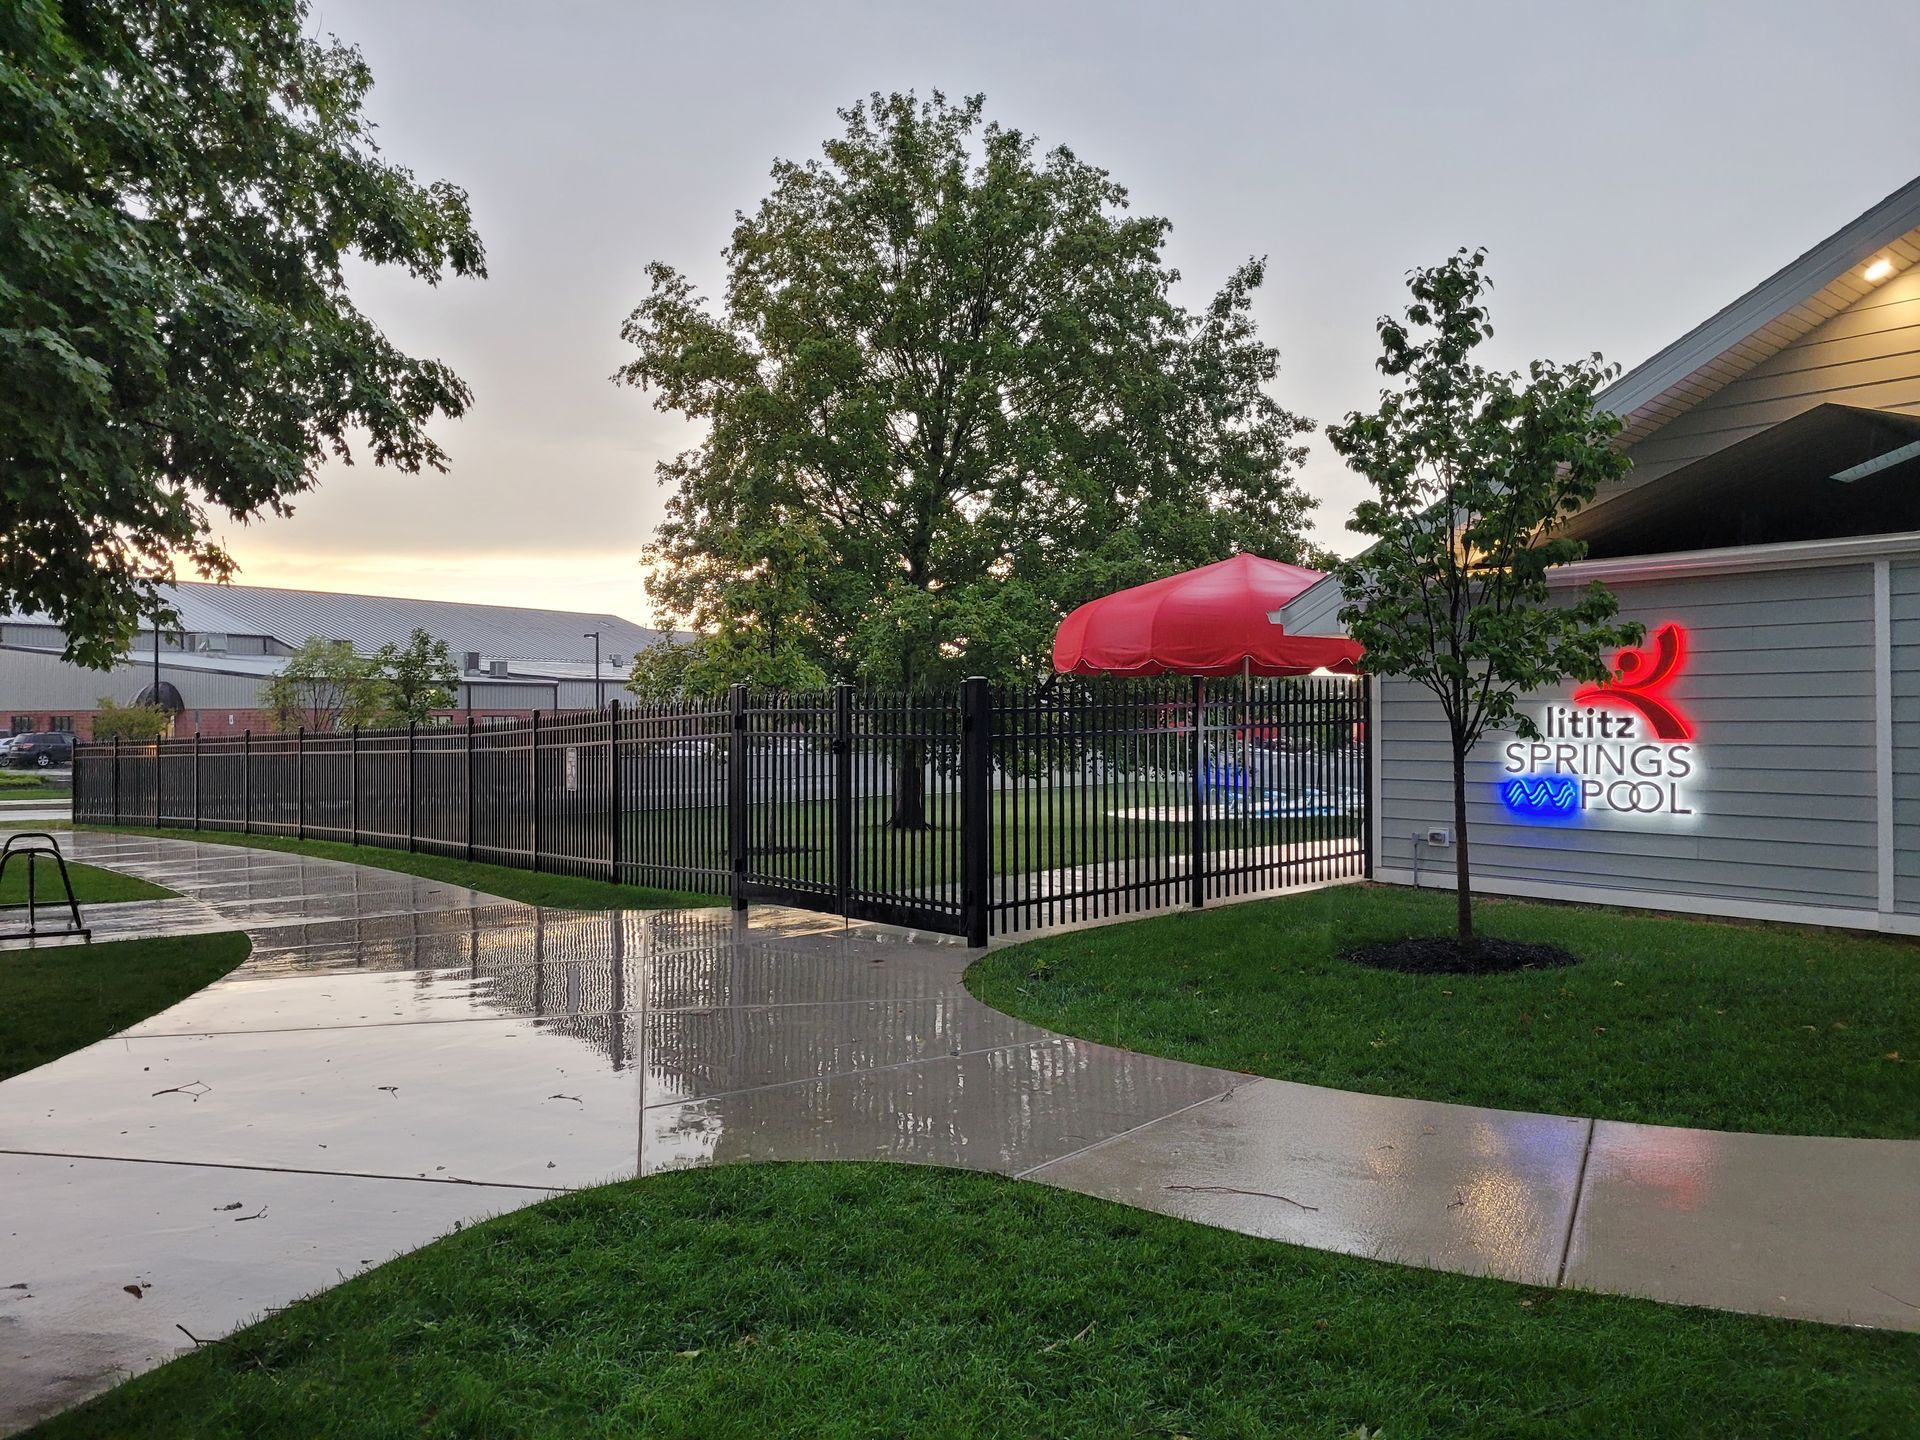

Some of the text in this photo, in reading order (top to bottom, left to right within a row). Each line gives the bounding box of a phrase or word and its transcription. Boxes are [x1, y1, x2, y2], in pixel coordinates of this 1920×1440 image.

[1547, 706, 1636, 739] lititz
[1505, 743, 1692, 778] SPRINGS
[1581, 780, 1692, 814] POOL
